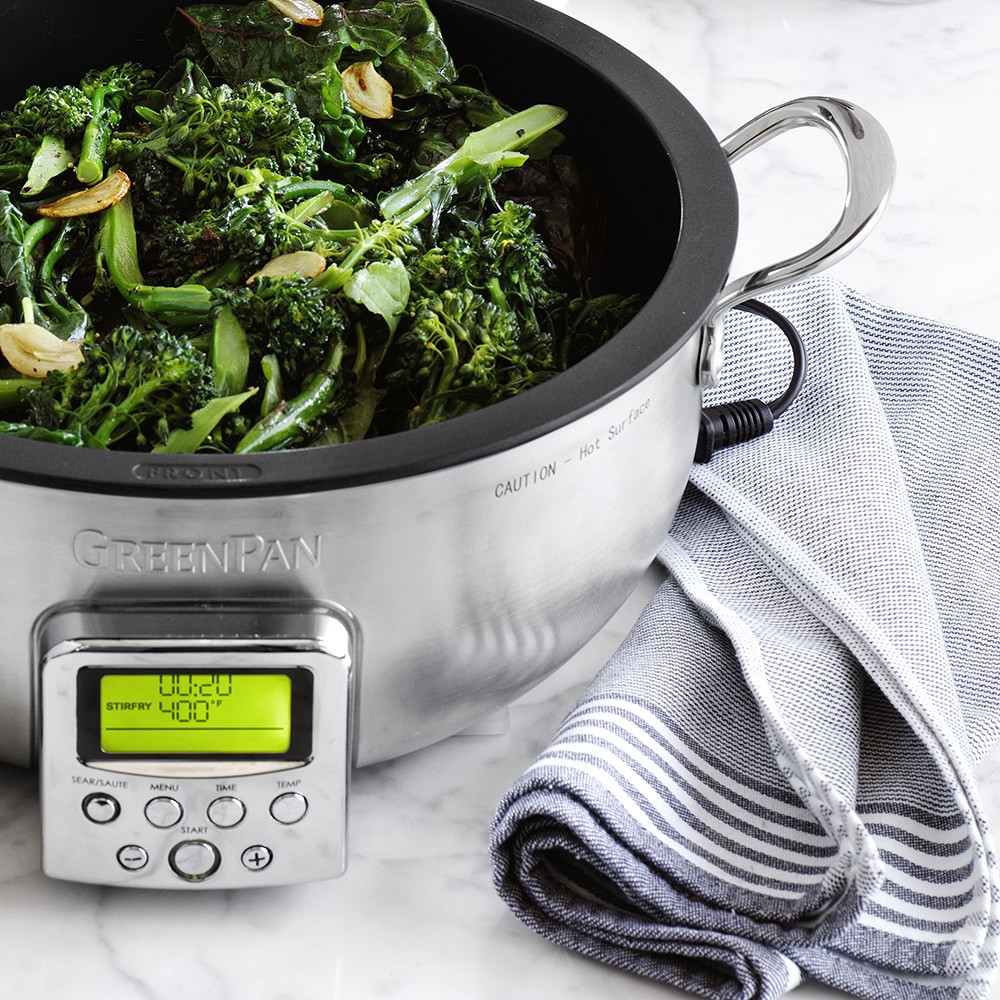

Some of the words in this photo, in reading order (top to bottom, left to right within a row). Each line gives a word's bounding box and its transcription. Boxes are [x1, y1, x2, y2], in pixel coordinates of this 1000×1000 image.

[494, 461, 556, 498] CAUTION
[579, 438, 601, 461] Hot
[607, 397, 651, 441] Surface
[73, 528, 322, 573] GREENPAN
[159, 674, 232, 697] 00:20
[106, 702, 152, 711] STIRFRY
[71, 775, 128, 789] SEAR/SAUTE
[276, 780, 302, 789] TEMP
[150, 783, 179, 792] MENU
[215, 783, 237, 792] TIME
[180, 826, 209, 835] START
